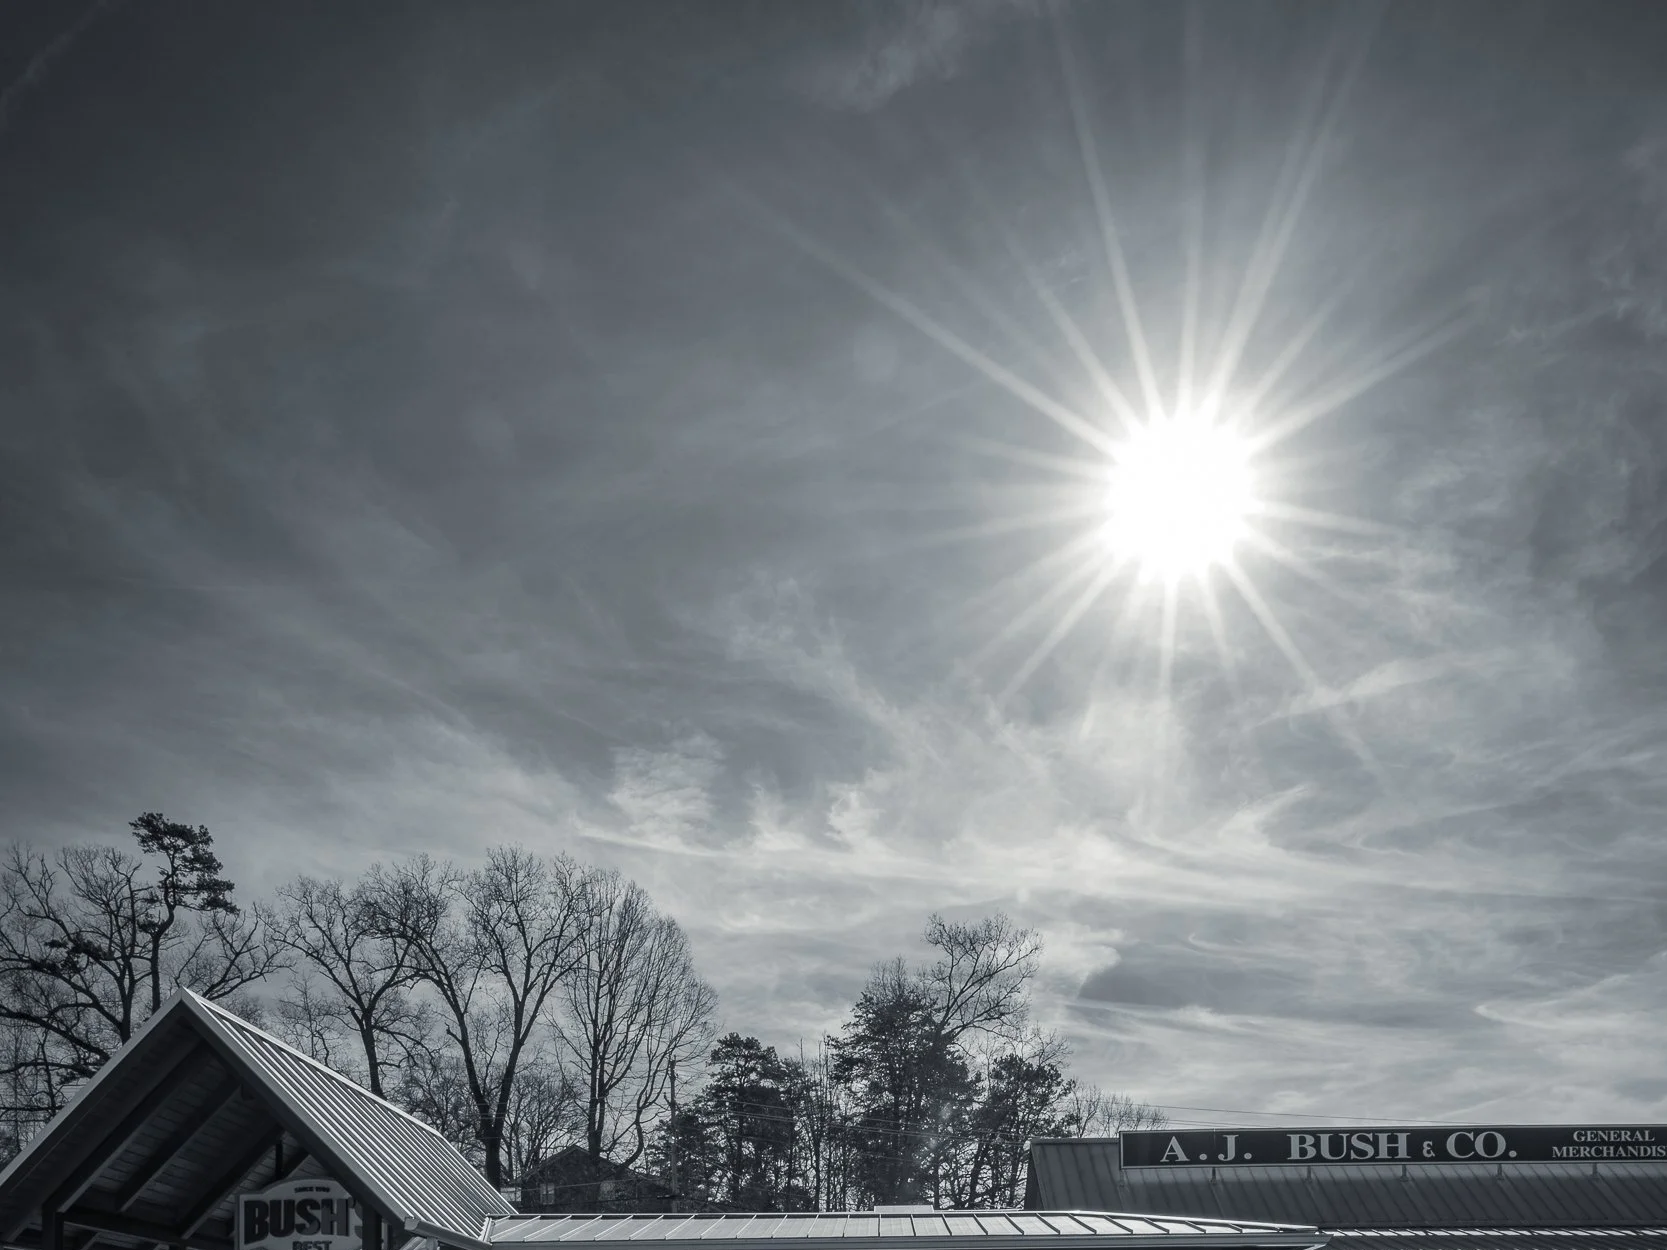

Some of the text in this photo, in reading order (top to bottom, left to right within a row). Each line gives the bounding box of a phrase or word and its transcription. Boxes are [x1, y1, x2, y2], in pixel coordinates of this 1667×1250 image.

[1572, 1130, 1656, 1142] GENERAL
[1286, 1132, 1411, 1160] BUSH
[1422, 1140, 1436, 1158] &
[1446, 1131, 1517, 1159] CO.
[1551, 1145, 1667, 1158] MERCHANDIS
